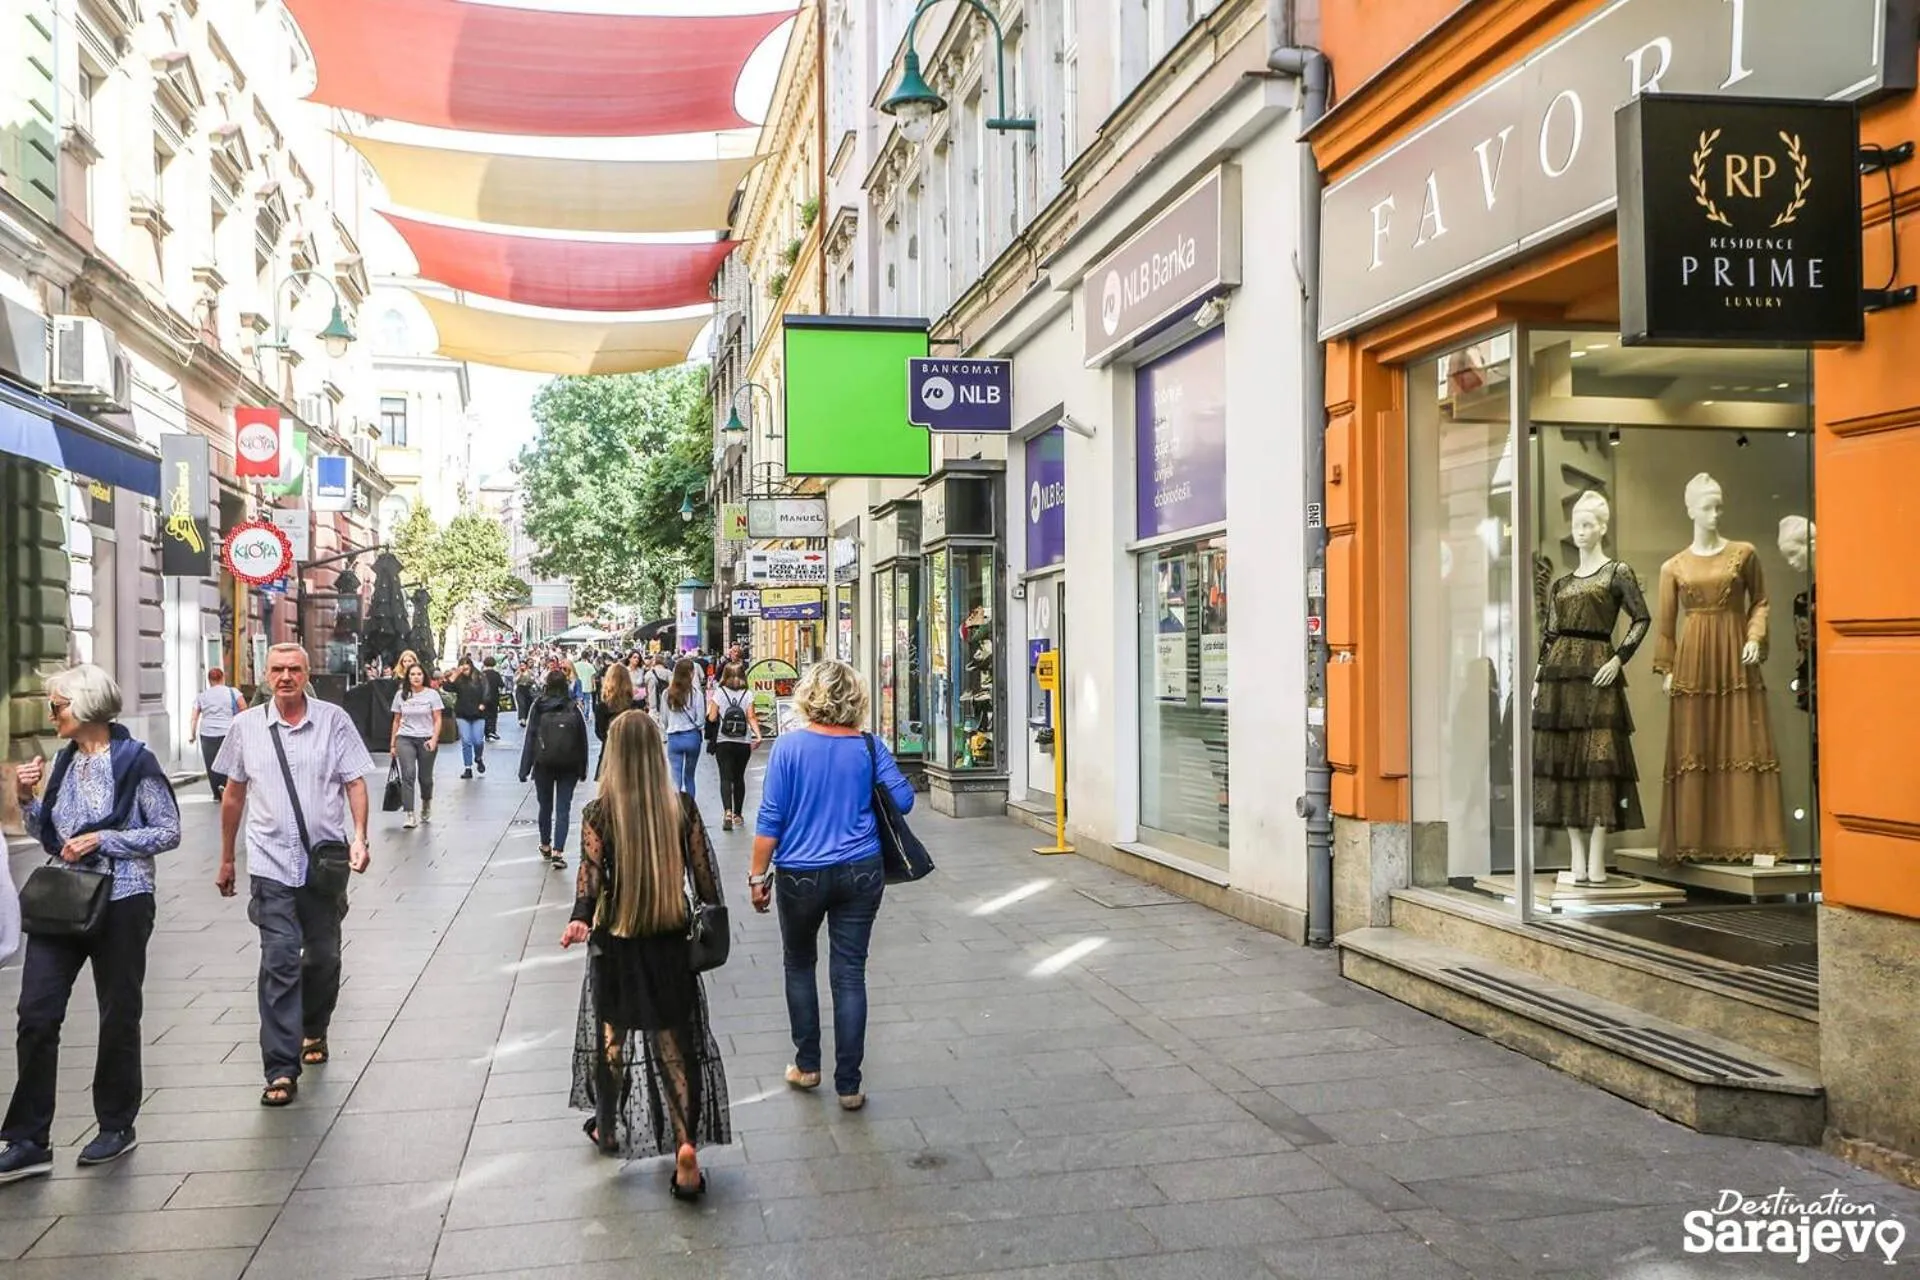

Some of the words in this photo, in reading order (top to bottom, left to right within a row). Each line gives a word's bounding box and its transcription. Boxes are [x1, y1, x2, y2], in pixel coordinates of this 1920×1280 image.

[1725, 154, 1777, 198] RP
[1710, 237, 1793, 250] RESIDENCE
[1123, 261, 1150, 311] NLB
[1152, 233, 1196, 291] Banka
[1681, 256, 1824, 288] PRIME
[1725, 297, 1783, 308] LUXURY
[922, 364, 1001, 375] BANKOMAT
[959, 385, 1001, 404] NLB
[1041, 484, 1056, 511] NLB
[1309, 504, 1319, 527] BNE
